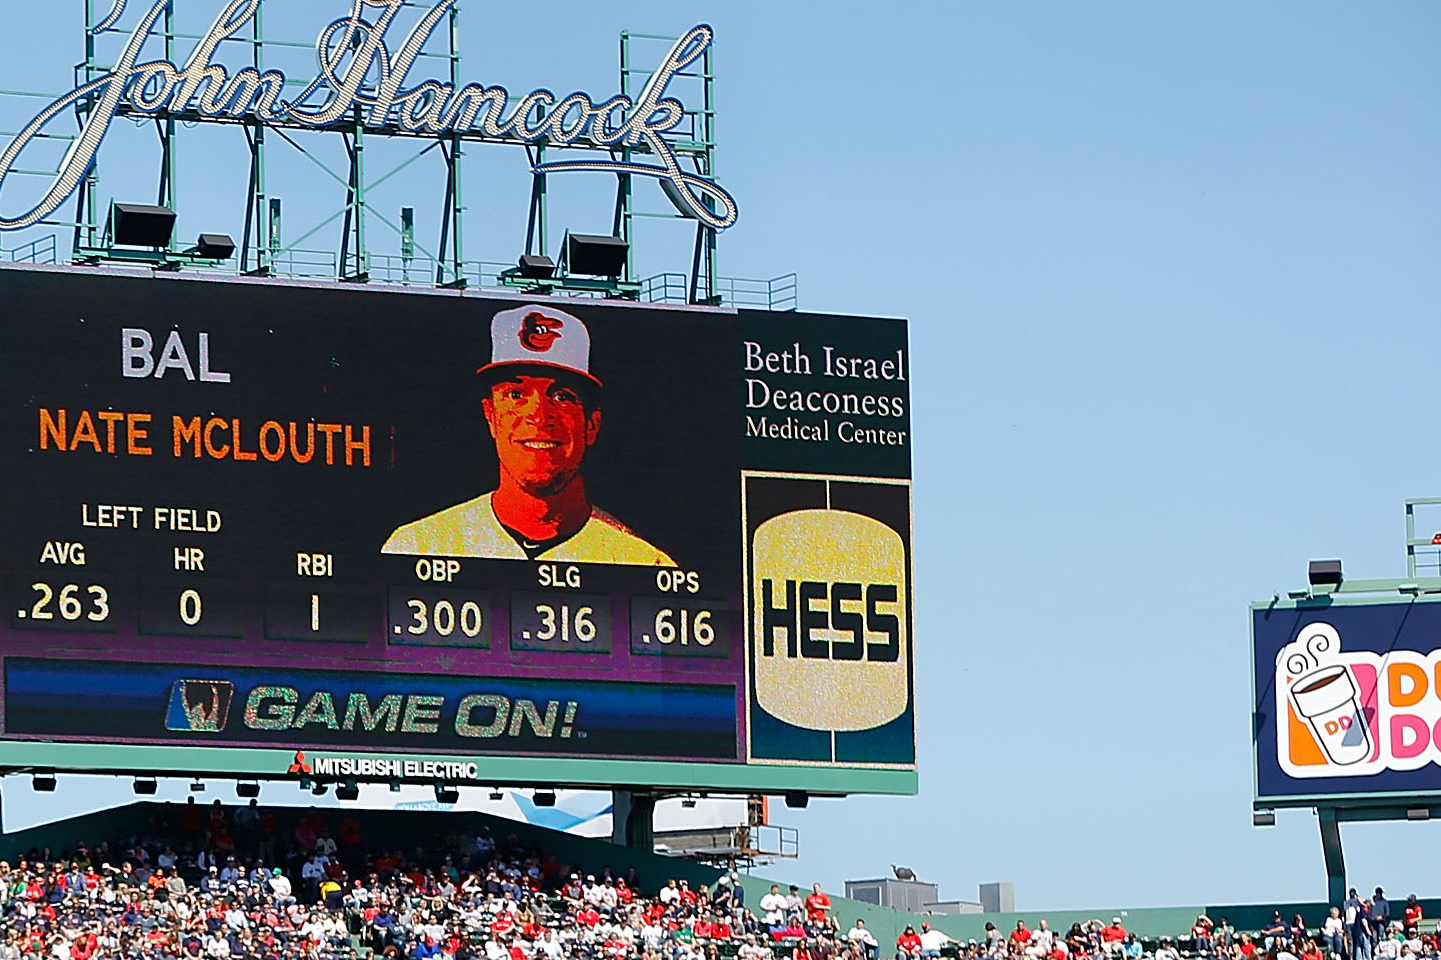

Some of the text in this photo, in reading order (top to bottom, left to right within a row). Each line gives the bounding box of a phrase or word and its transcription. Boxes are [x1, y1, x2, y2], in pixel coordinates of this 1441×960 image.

[282, 0, 738, 230] Hancock
[121, 327, 232, 383] BAL
[743, 341, 906, 381] Beth Israel
[744, 379, 904, 417] Deaconess
[39, 407, 371, 467] NATE MCLOUTH
[745, 415, 907, 446] Medical Center
[81, 503, 222, 533] LEFT FIELD
[39, 541, 700, 593] AVG HR RBI OBP SLG OPS
[17, 582, 110, 622] .263
[179, 589, 202, 626] 0
[393, 599, 483, 638] .300
[522, 604, 597, 642] .316
[641, 608, 715, 646] .616
[761, 578, 899, 663] HESS
[243, 686, 446, 733] GAME
[314, 756, 479, 779] MITSUBISHI ELECTRIC
